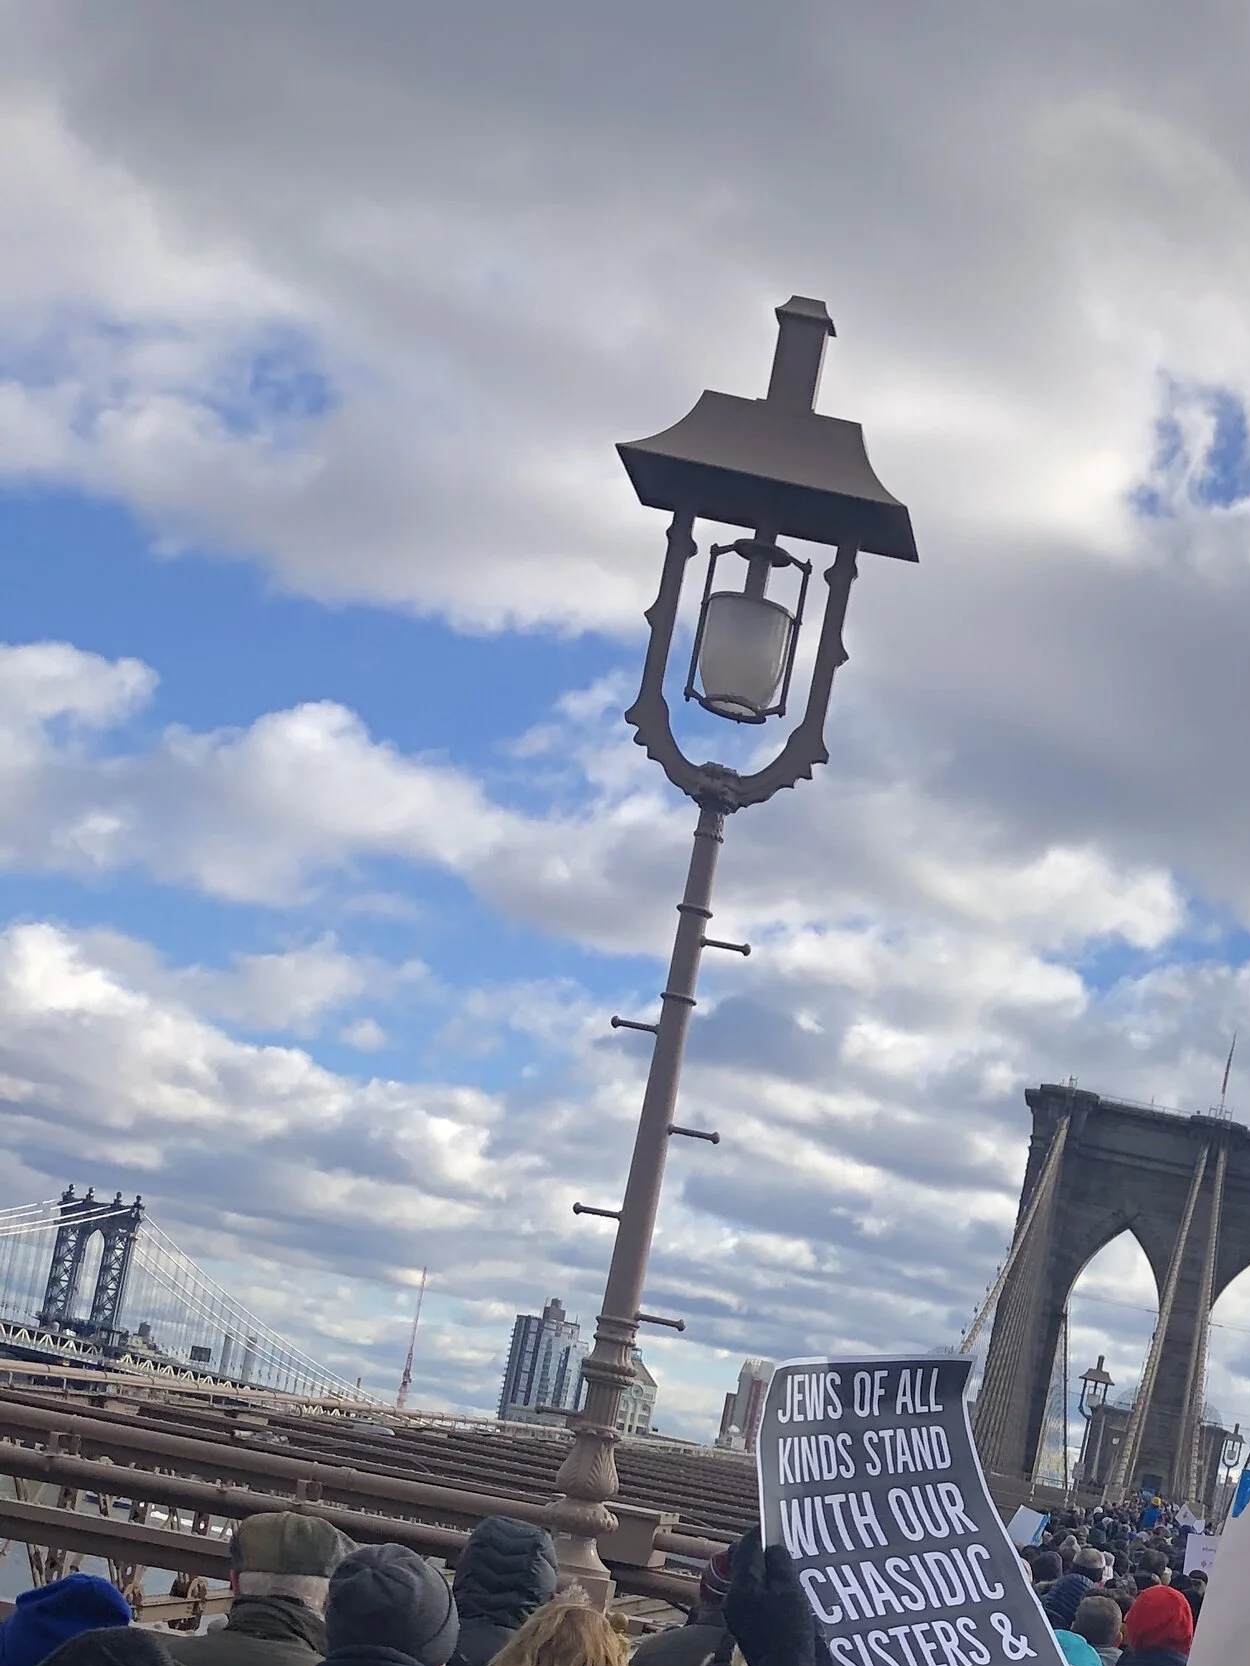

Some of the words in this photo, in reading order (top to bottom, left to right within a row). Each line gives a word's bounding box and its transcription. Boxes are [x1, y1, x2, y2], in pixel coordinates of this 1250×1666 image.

[777, 1371, 842, 1424] JEWS
[853, 1369, 888, 1419] OF
[895, 1367, 943, 1416] ALL
[777, 1432, 856, 1485] KINDS
[865, 1425, 952, 1477] STAND
[779, 1492, 888, 1560] WITH
[889, 1481, 979, 1542] OUR
[799, 1543, 1005, 1625] CHASIDIC
[989, 1612, 1037, 1661] &
